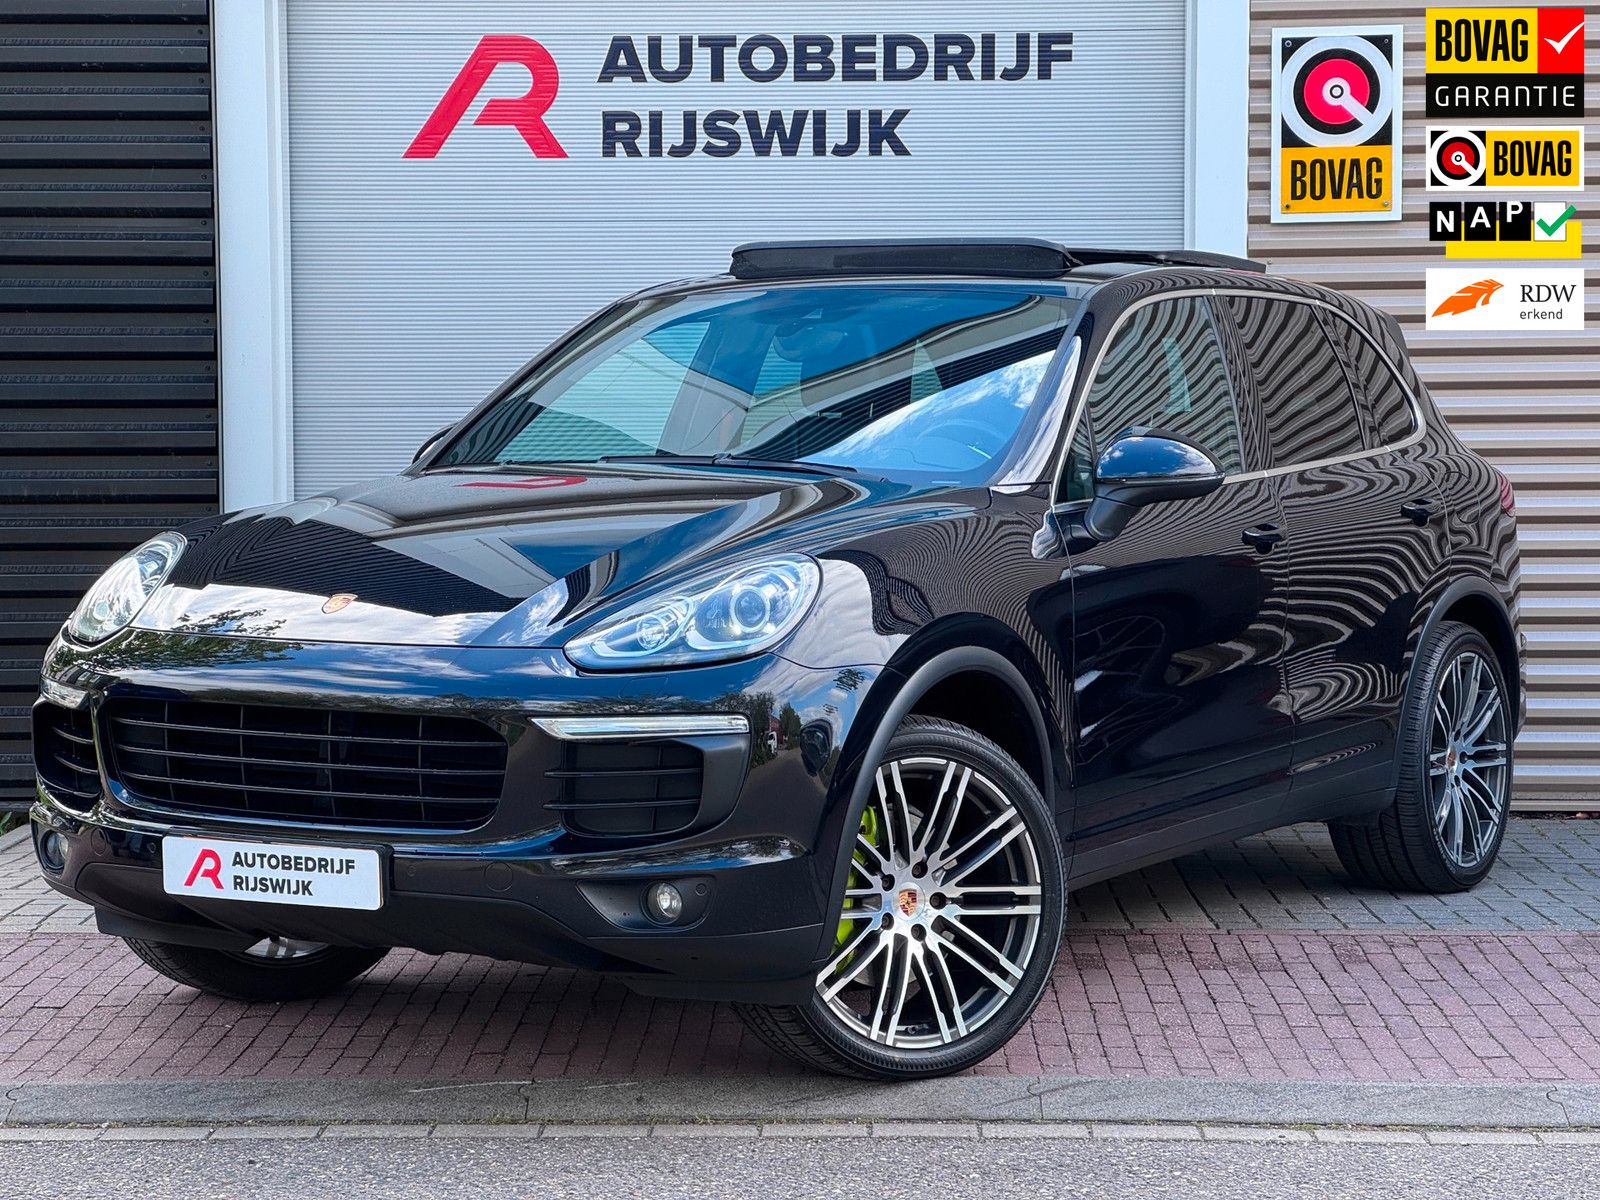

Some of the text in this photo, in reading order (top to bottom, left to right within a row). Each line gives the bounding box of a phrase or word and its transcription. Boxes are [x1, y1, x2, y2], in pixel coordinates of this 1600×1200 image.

[597, 32, 1075, 83] AUTOBEDRIJF
[601, 109, 912, 157] RIJSWIJK
[1290, 157, 1383, 201] BOVAG
[231, 851, 356, 875] AUTOBEDRIJF
[233, 875, 314, 896] RIJSWIJK
